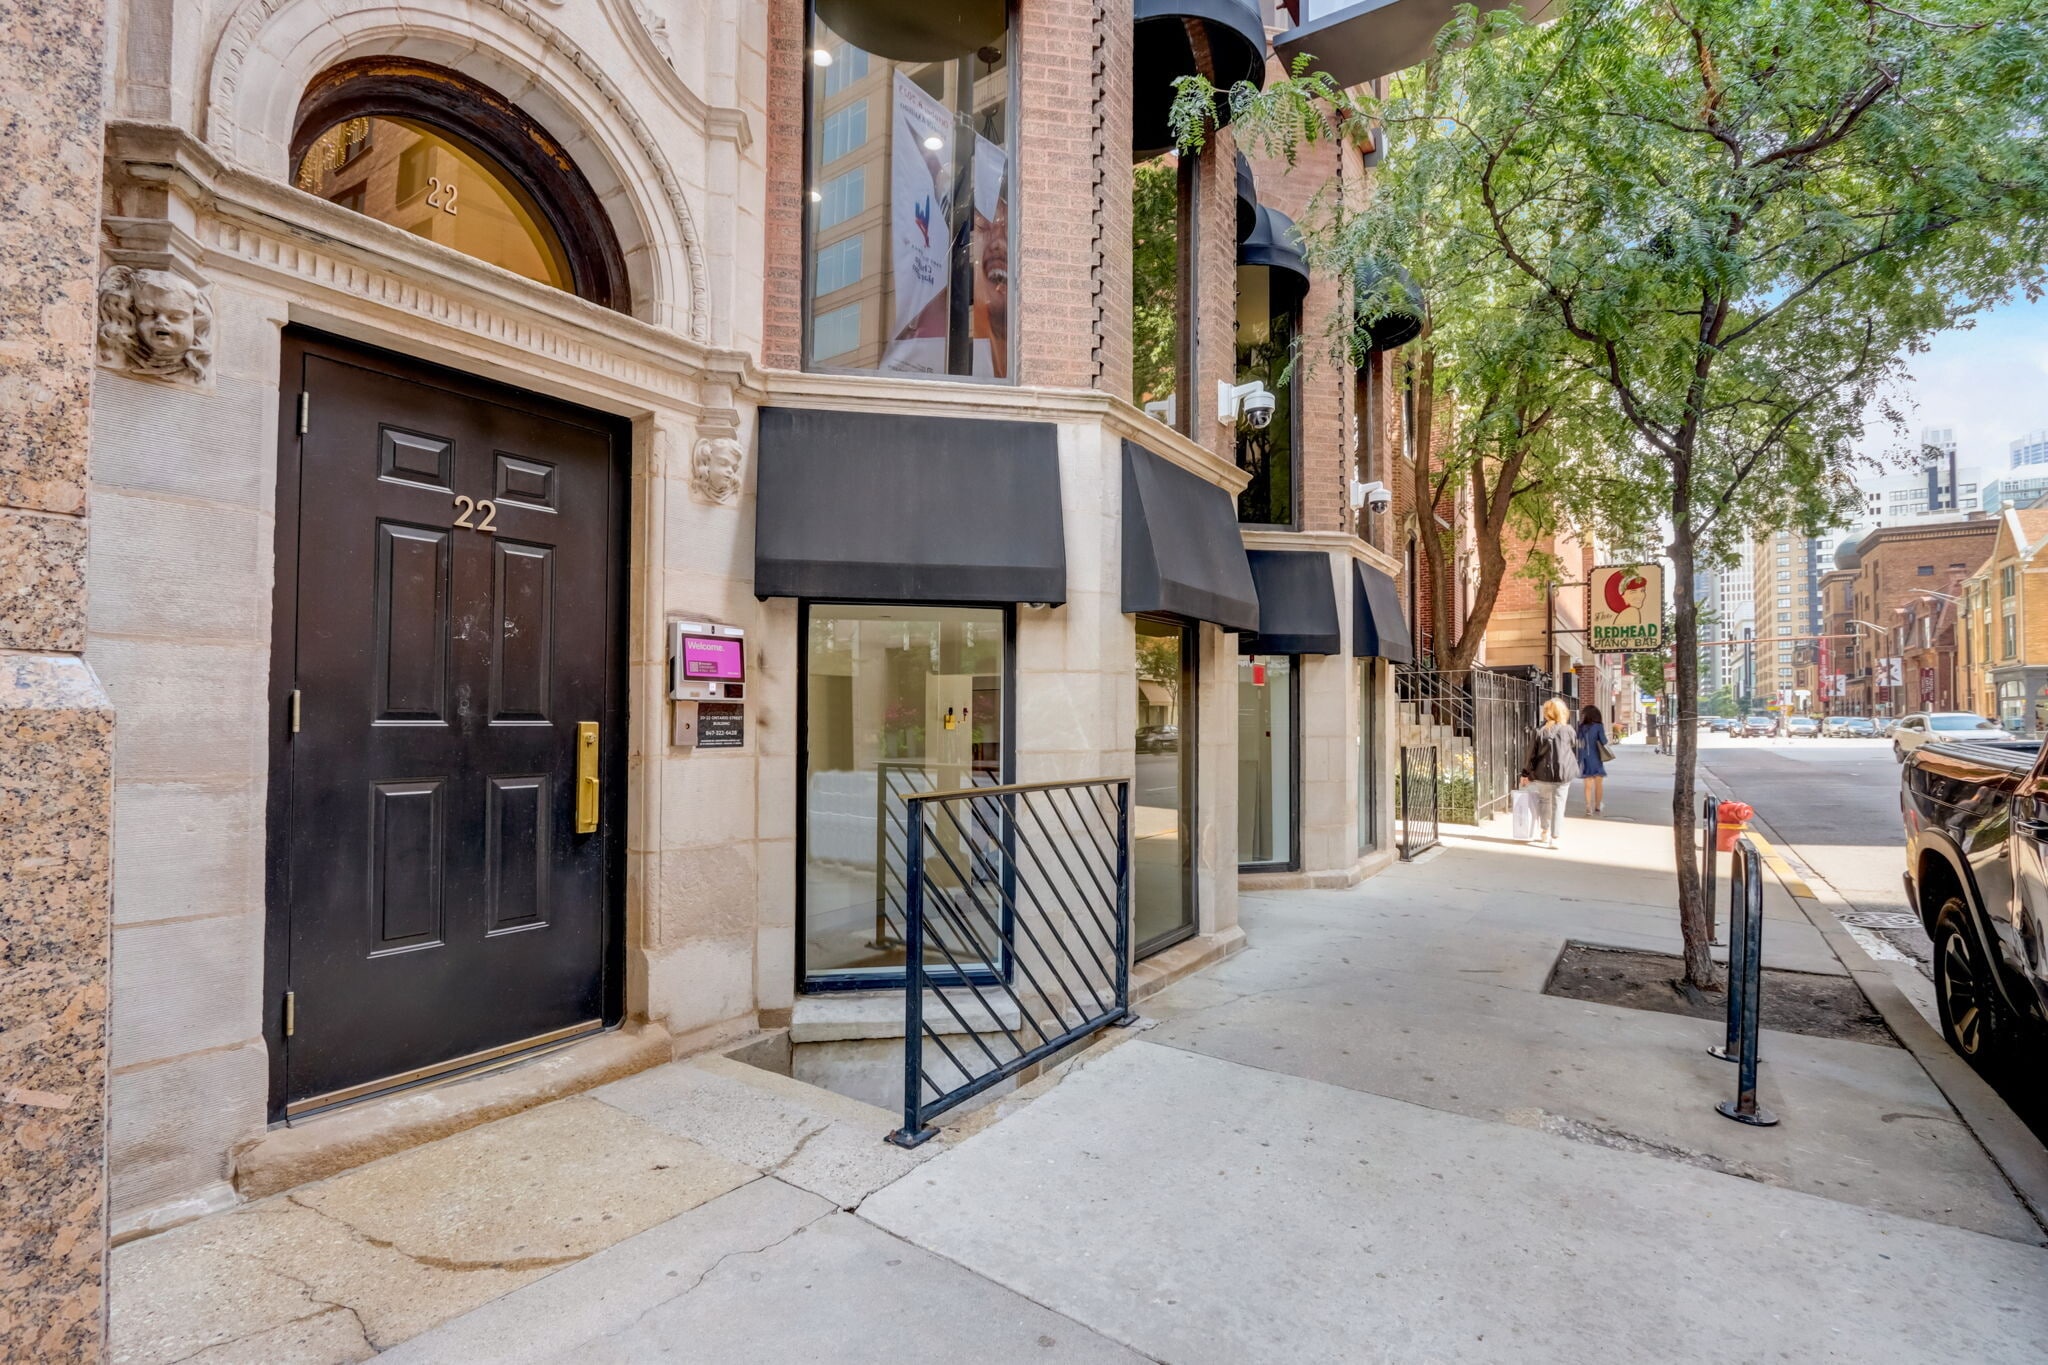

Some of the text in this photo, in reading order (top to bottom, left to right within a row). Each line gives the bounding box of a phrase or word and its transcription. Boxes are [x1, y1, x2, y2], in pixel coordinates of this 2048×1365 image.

[426, 176, 458, 216] 22
[453, 495, 497, 531] 22
[1594, 623, 1658, 639] REDHEAD
[1594, 637, 1658, 648] PIANO BAR
